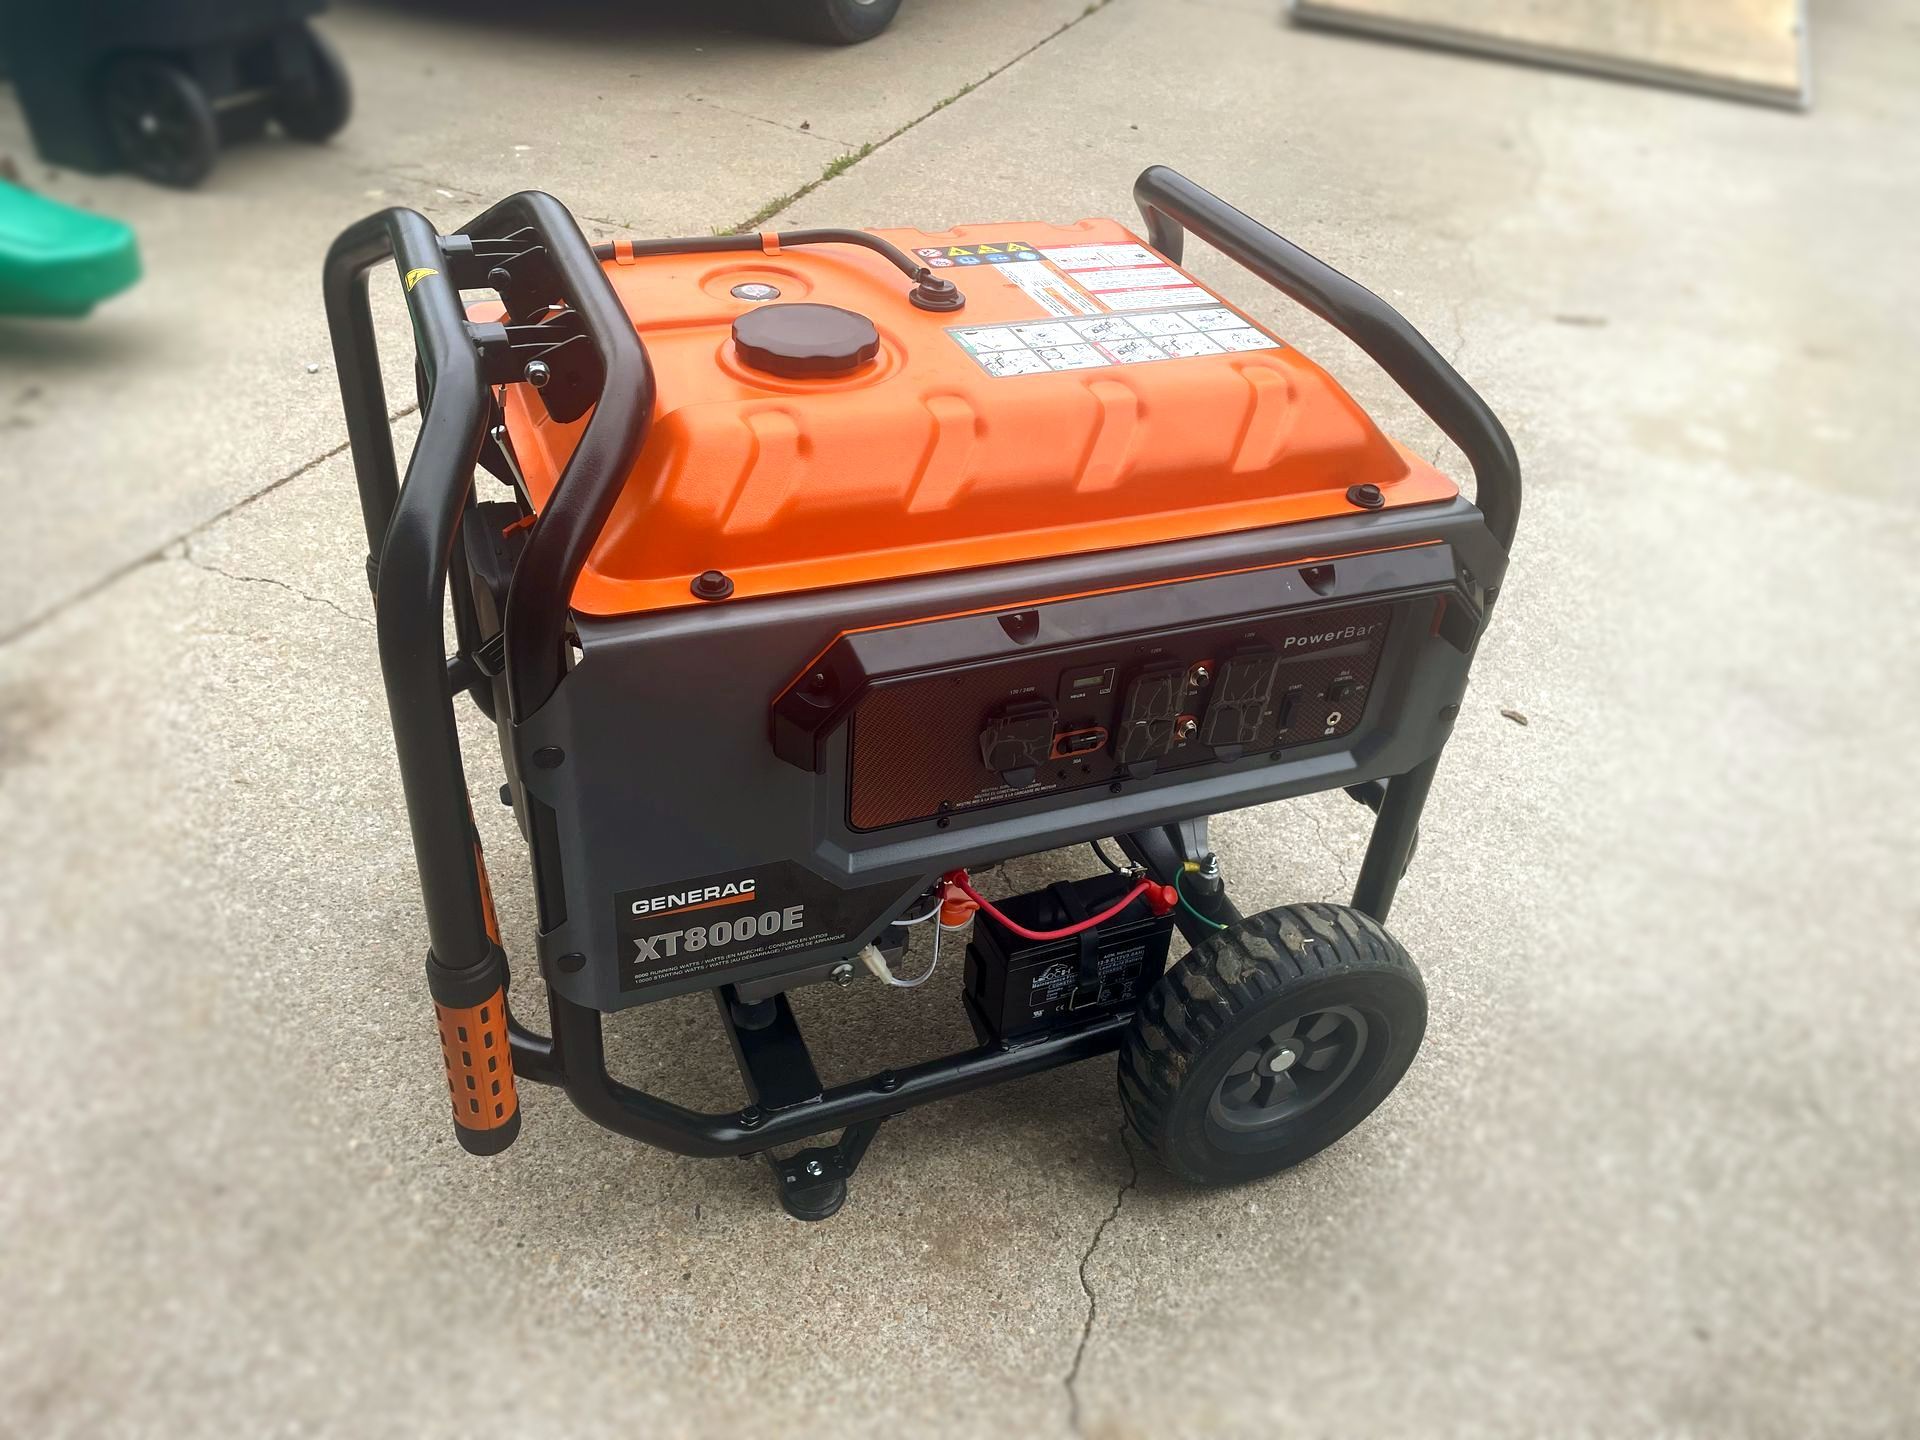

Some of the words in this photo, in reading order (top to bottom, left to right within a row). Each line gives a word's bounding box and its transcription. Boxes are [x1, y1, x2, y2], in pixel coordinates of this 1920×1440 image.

[1284, 625, 1375, 649] PowerBar
[631, 878, 756, 915] GENERAC
[633, 904, 804, 964] XT8000E
[650, 966, 679, 976] RUNNING
[680, 961, 700, 970] WATTS
[705, 956, 725, 964] WATTS
[768, 940, 799, 950] CONSUMO
[653, 970, 683, 981] STARTING
[684, 966, 705, 974] WATTS
[709, 960, 730, 968] WATTS
[784, 942, 805, 951] VATIOS
[1032, 977, 1066, 989] Maintenance
